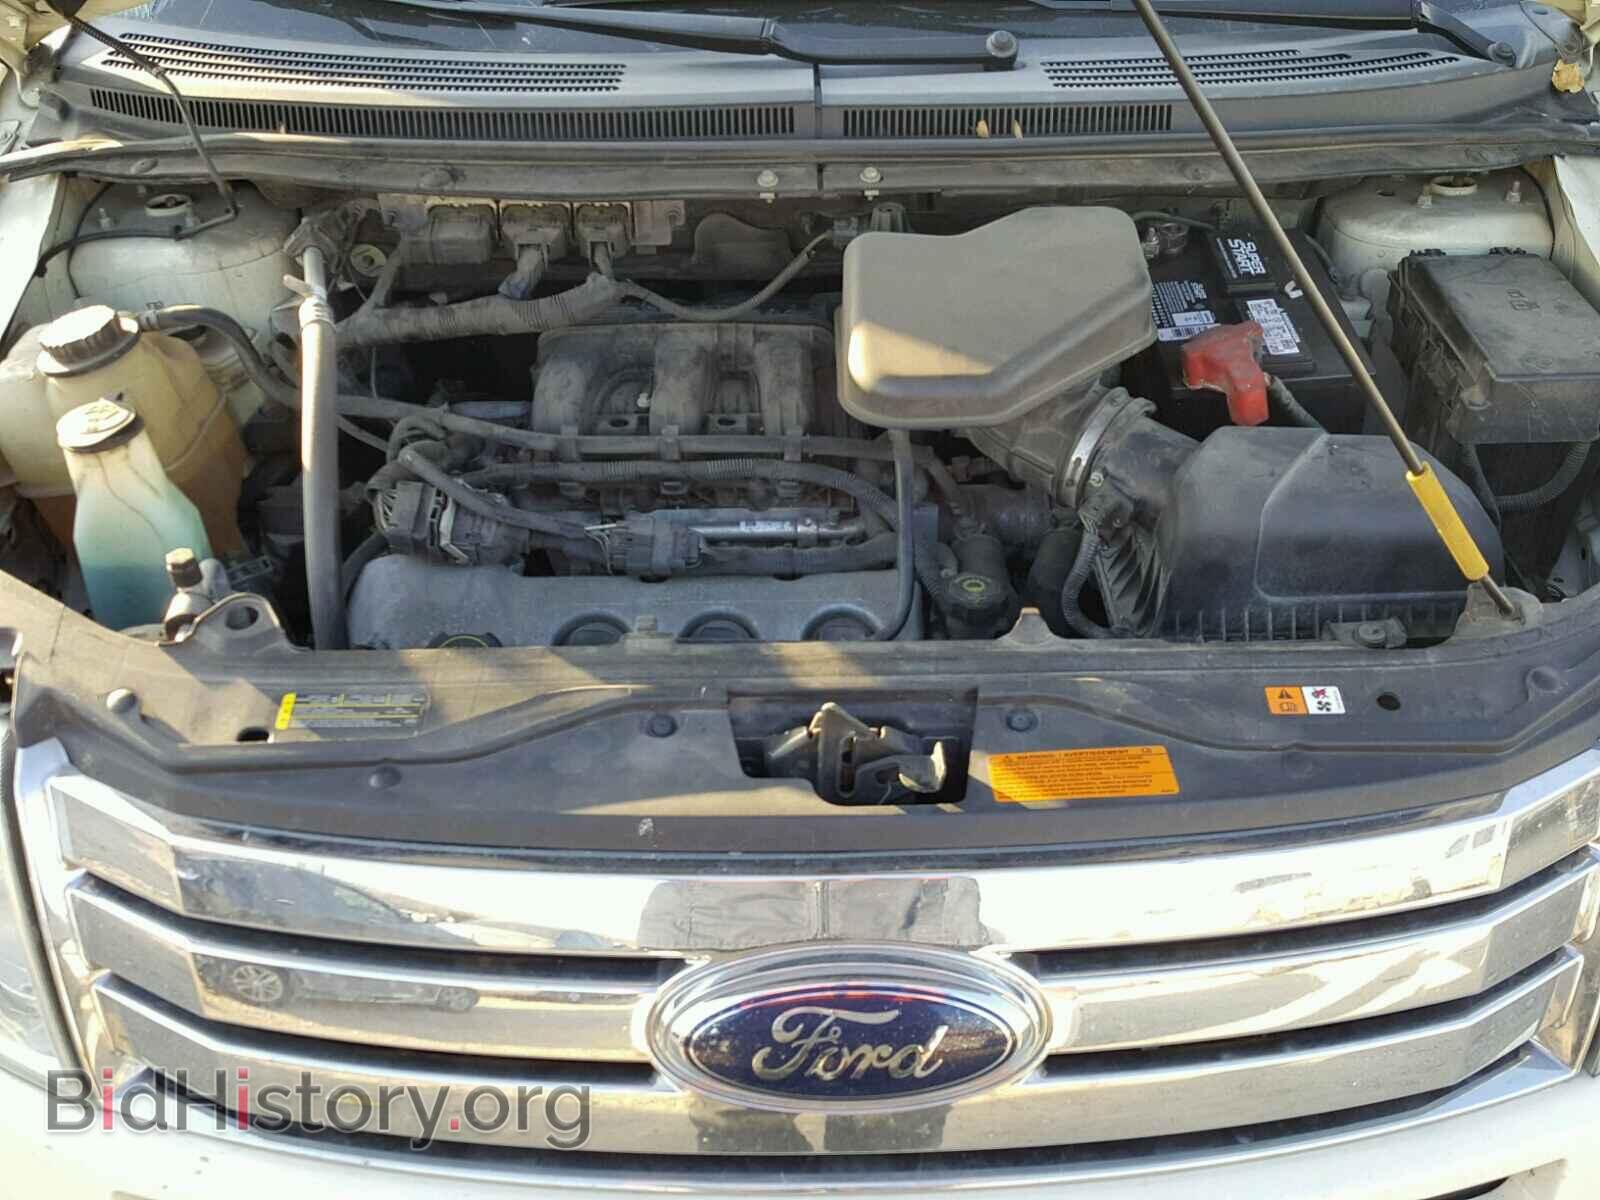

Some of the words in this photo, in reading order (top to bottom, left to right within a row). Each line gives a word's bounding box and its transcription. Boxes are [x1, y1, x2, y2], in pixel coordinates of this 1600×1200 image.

[1227, 238, 1255, 275] START
[1245, 241, 1266, 274] SUPER
[752, 1006, 949, 1081] Ford
